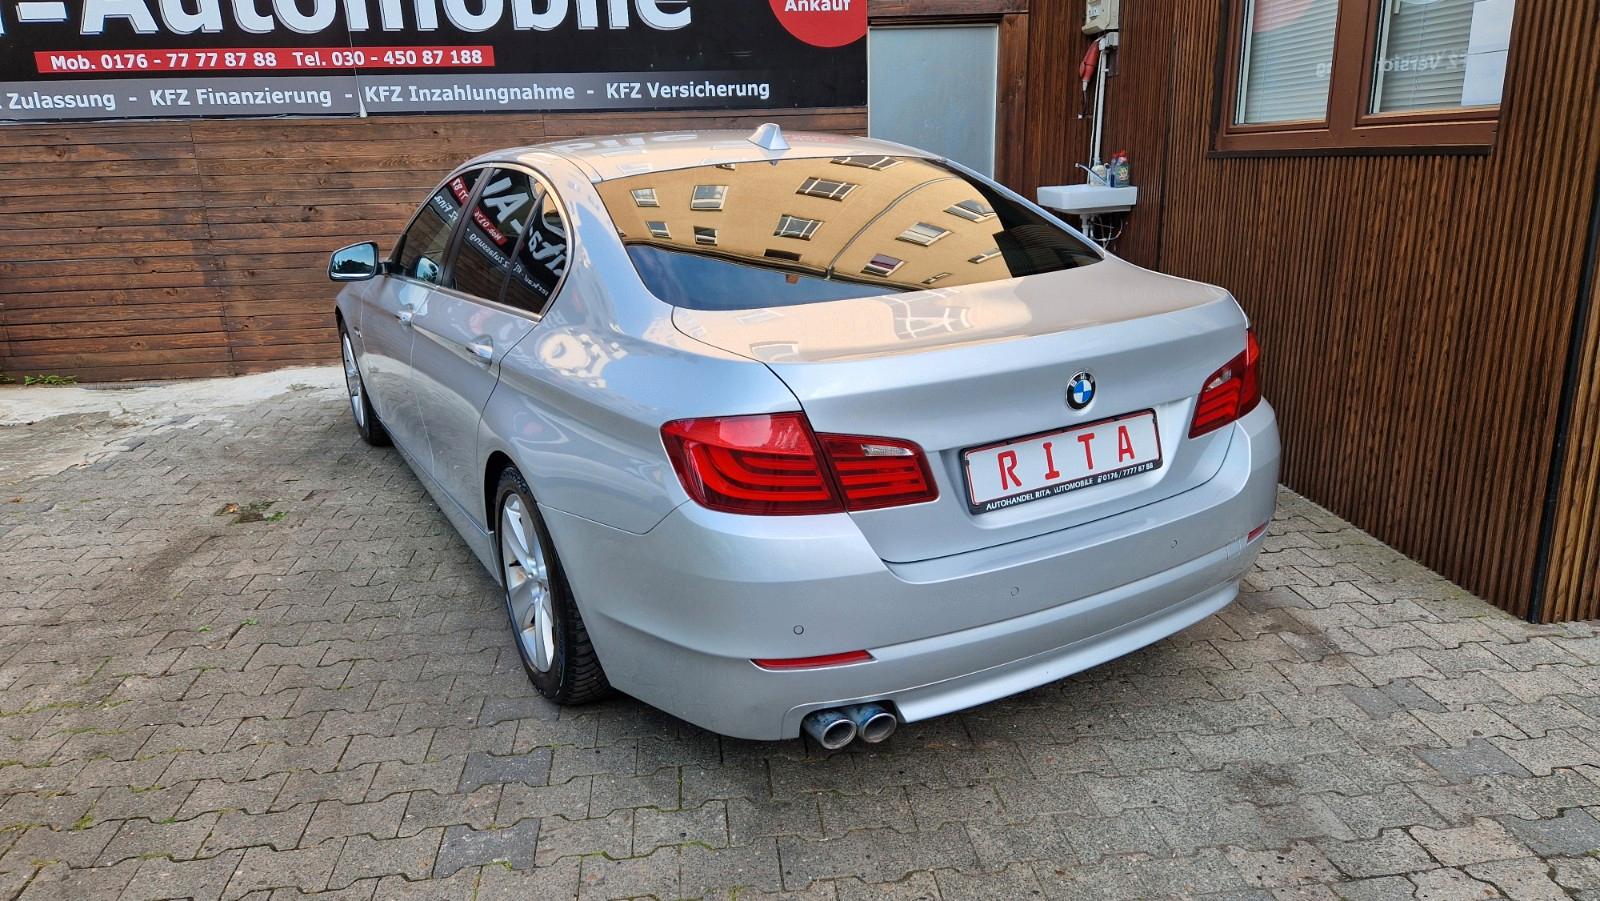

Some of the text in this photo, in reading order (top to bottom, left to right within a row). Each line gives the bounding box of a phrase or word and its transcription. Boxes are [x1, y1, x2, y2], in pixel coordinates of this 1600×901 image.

[784, 0, 851, 12] Ankauf
[50, 54, 96, 70] Mob.
[100, 53, 148, 69] 0176
[166, 53, 189, 68] 77
[195, 53, 218, 67] 77
[224, 52, 247, 67] 87
[253, 52, 277, 67] 88
[292, 51, 326, 67] Tel.
[331, 50, 365, 66] 030
[383, 50, 417, 65] 450
[422, 50, 443, 65] 87
[450, 49, 483, 64] 188
[6, 91, 116, 111] Zulassung
[149, 89, 191, 106] KFZ
[195, 87, 332, 108] Finanzierung
[364, 85, 403, 103] KFZ
[408, 83, 575, 104] Inzahlungnahme
[606, 82, 642, 99] KFZ
[646, 80, 770, 100] Versicherung
[998, 425, 1135, 490] RITA
[986, 493, 1035, 511] AUTOHANDEL
